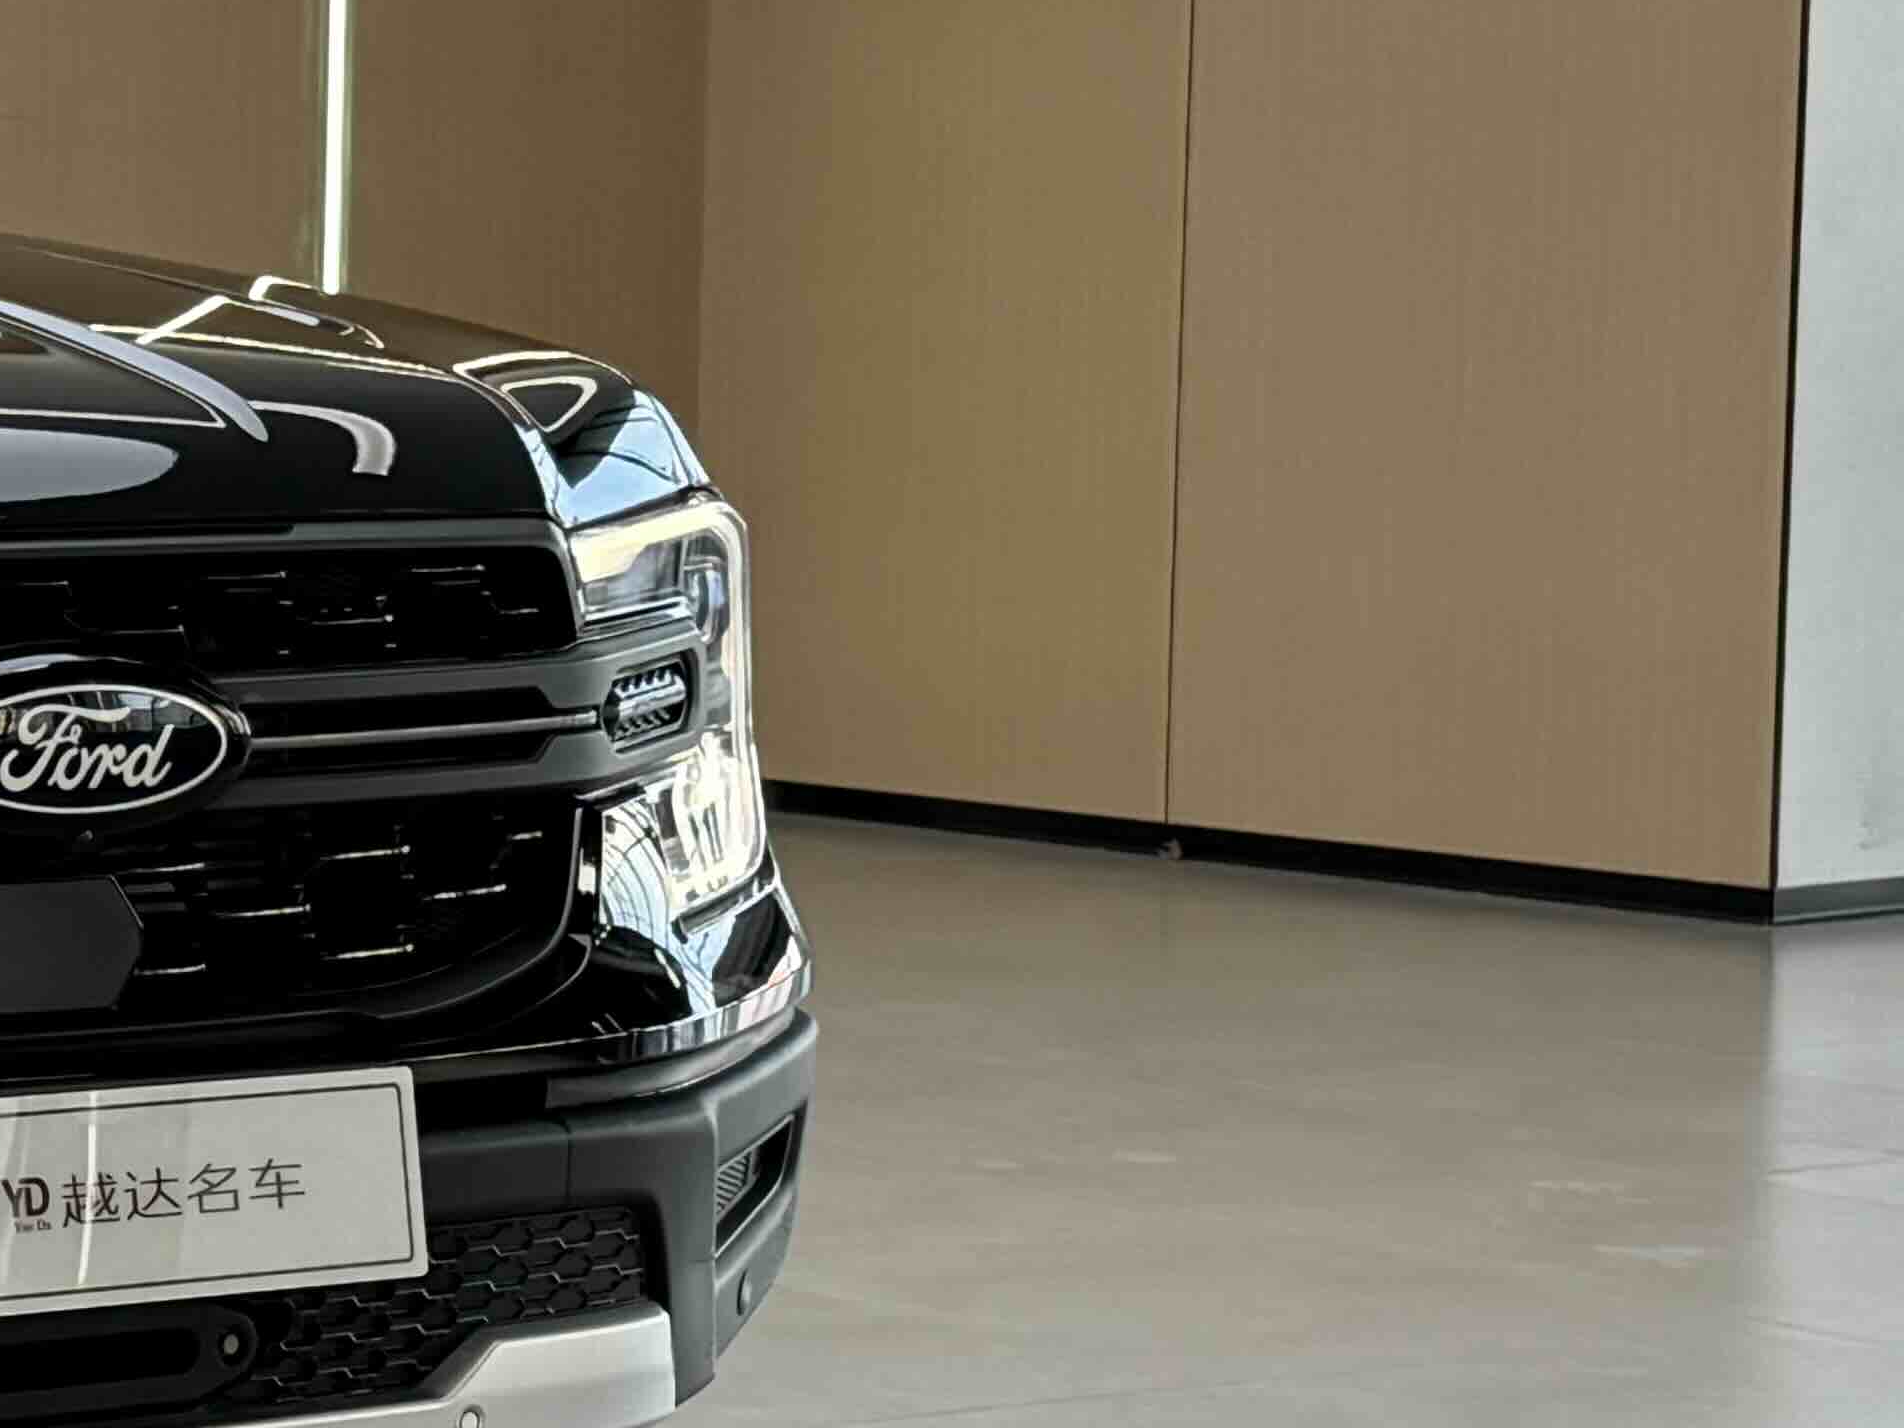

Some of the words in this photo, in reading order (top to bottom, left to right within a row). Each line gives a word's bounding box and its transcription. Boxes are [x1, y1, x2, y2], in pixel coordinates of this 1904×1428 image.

[0, 703, 176, 792] Ford
[1, 1177, 50, 1217] YD
[62, 1159, 305, 1228] 越达名车
